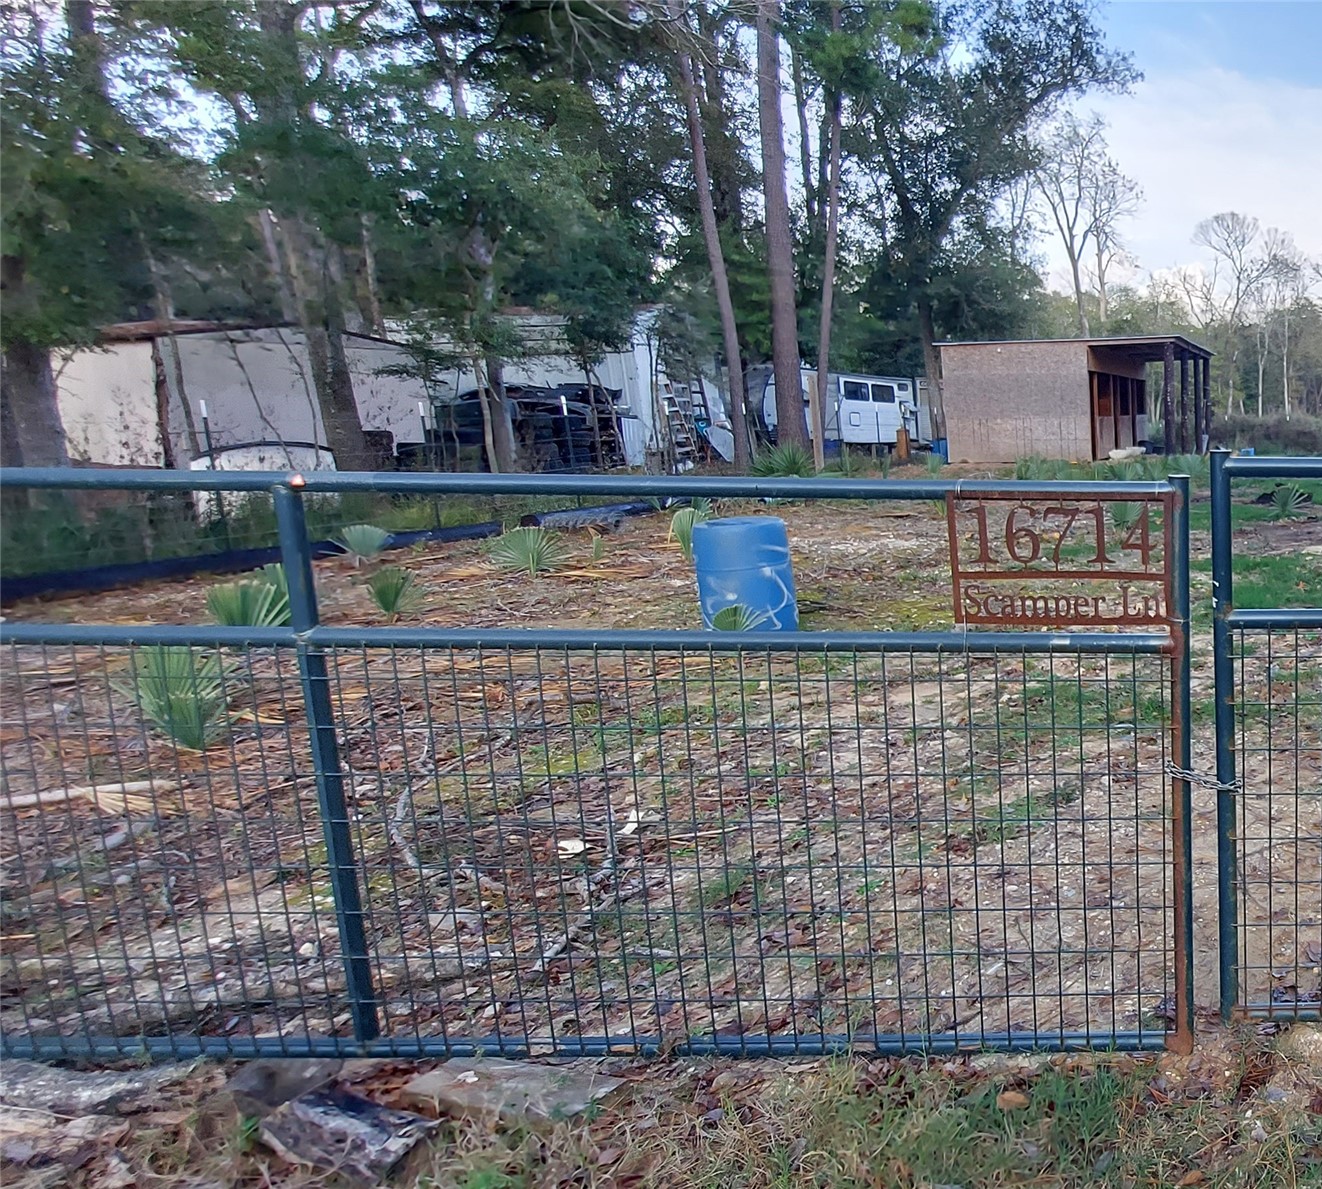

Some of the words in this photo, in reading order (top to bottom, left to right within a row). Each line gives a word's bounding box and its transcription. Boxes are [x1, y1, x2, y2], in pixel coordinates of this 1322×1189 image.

[966, 505, 1157, 565] 16714
[963, 583, 1106, 622] Scamper
[1121, 585, 1162, 619] Ln
